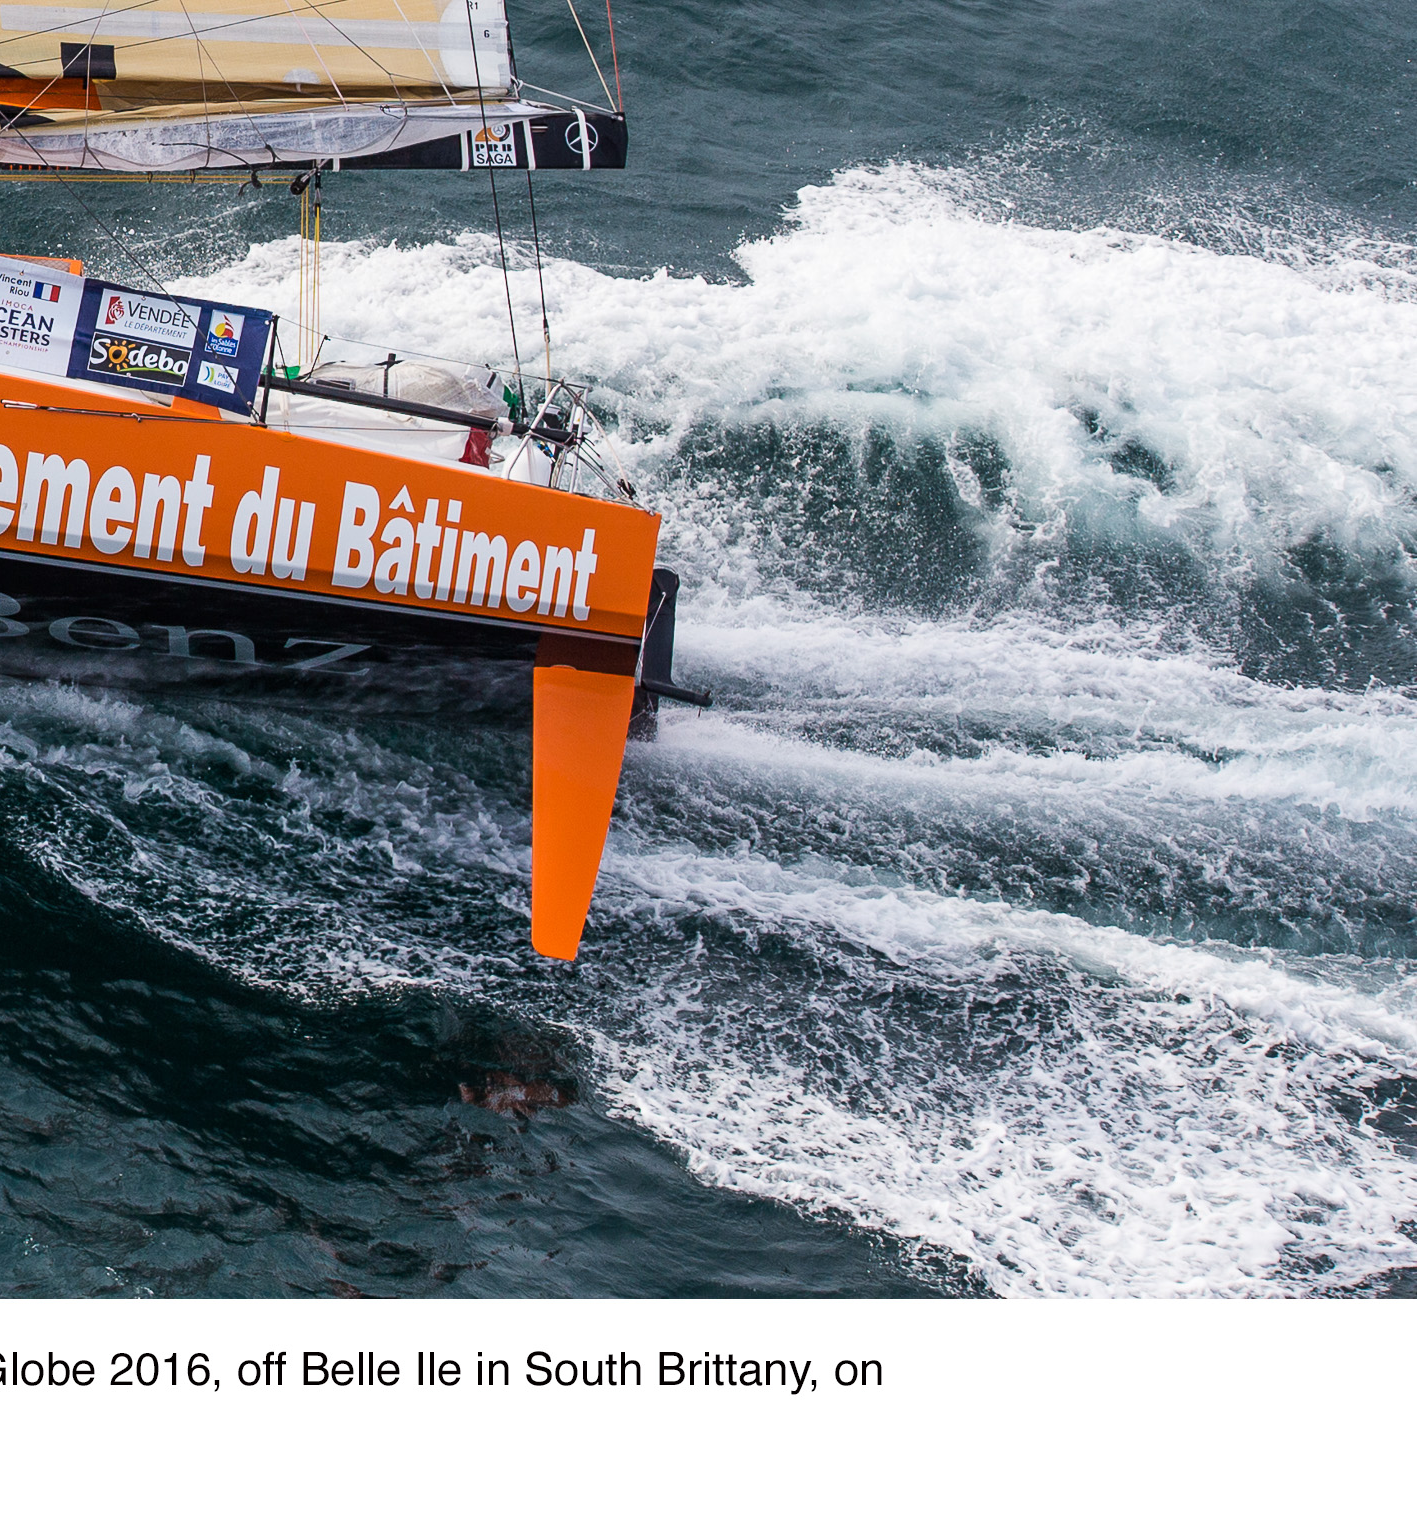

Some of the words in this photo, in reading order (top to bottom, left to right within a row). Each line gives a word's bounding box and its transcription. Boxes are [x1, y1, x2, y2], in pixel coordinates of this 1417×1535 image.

[476, 153, 513, 165] SAGA
[9, 286, 30, 297] Riou
[1, 299, 33, 311] IMOCA
[128, 301, 191, 329] VENDÉE
[89, 338, 188, 375] Sodebo
[230, 467, 315, 581] du
[331, 481, 597, 622] Bâtiment
